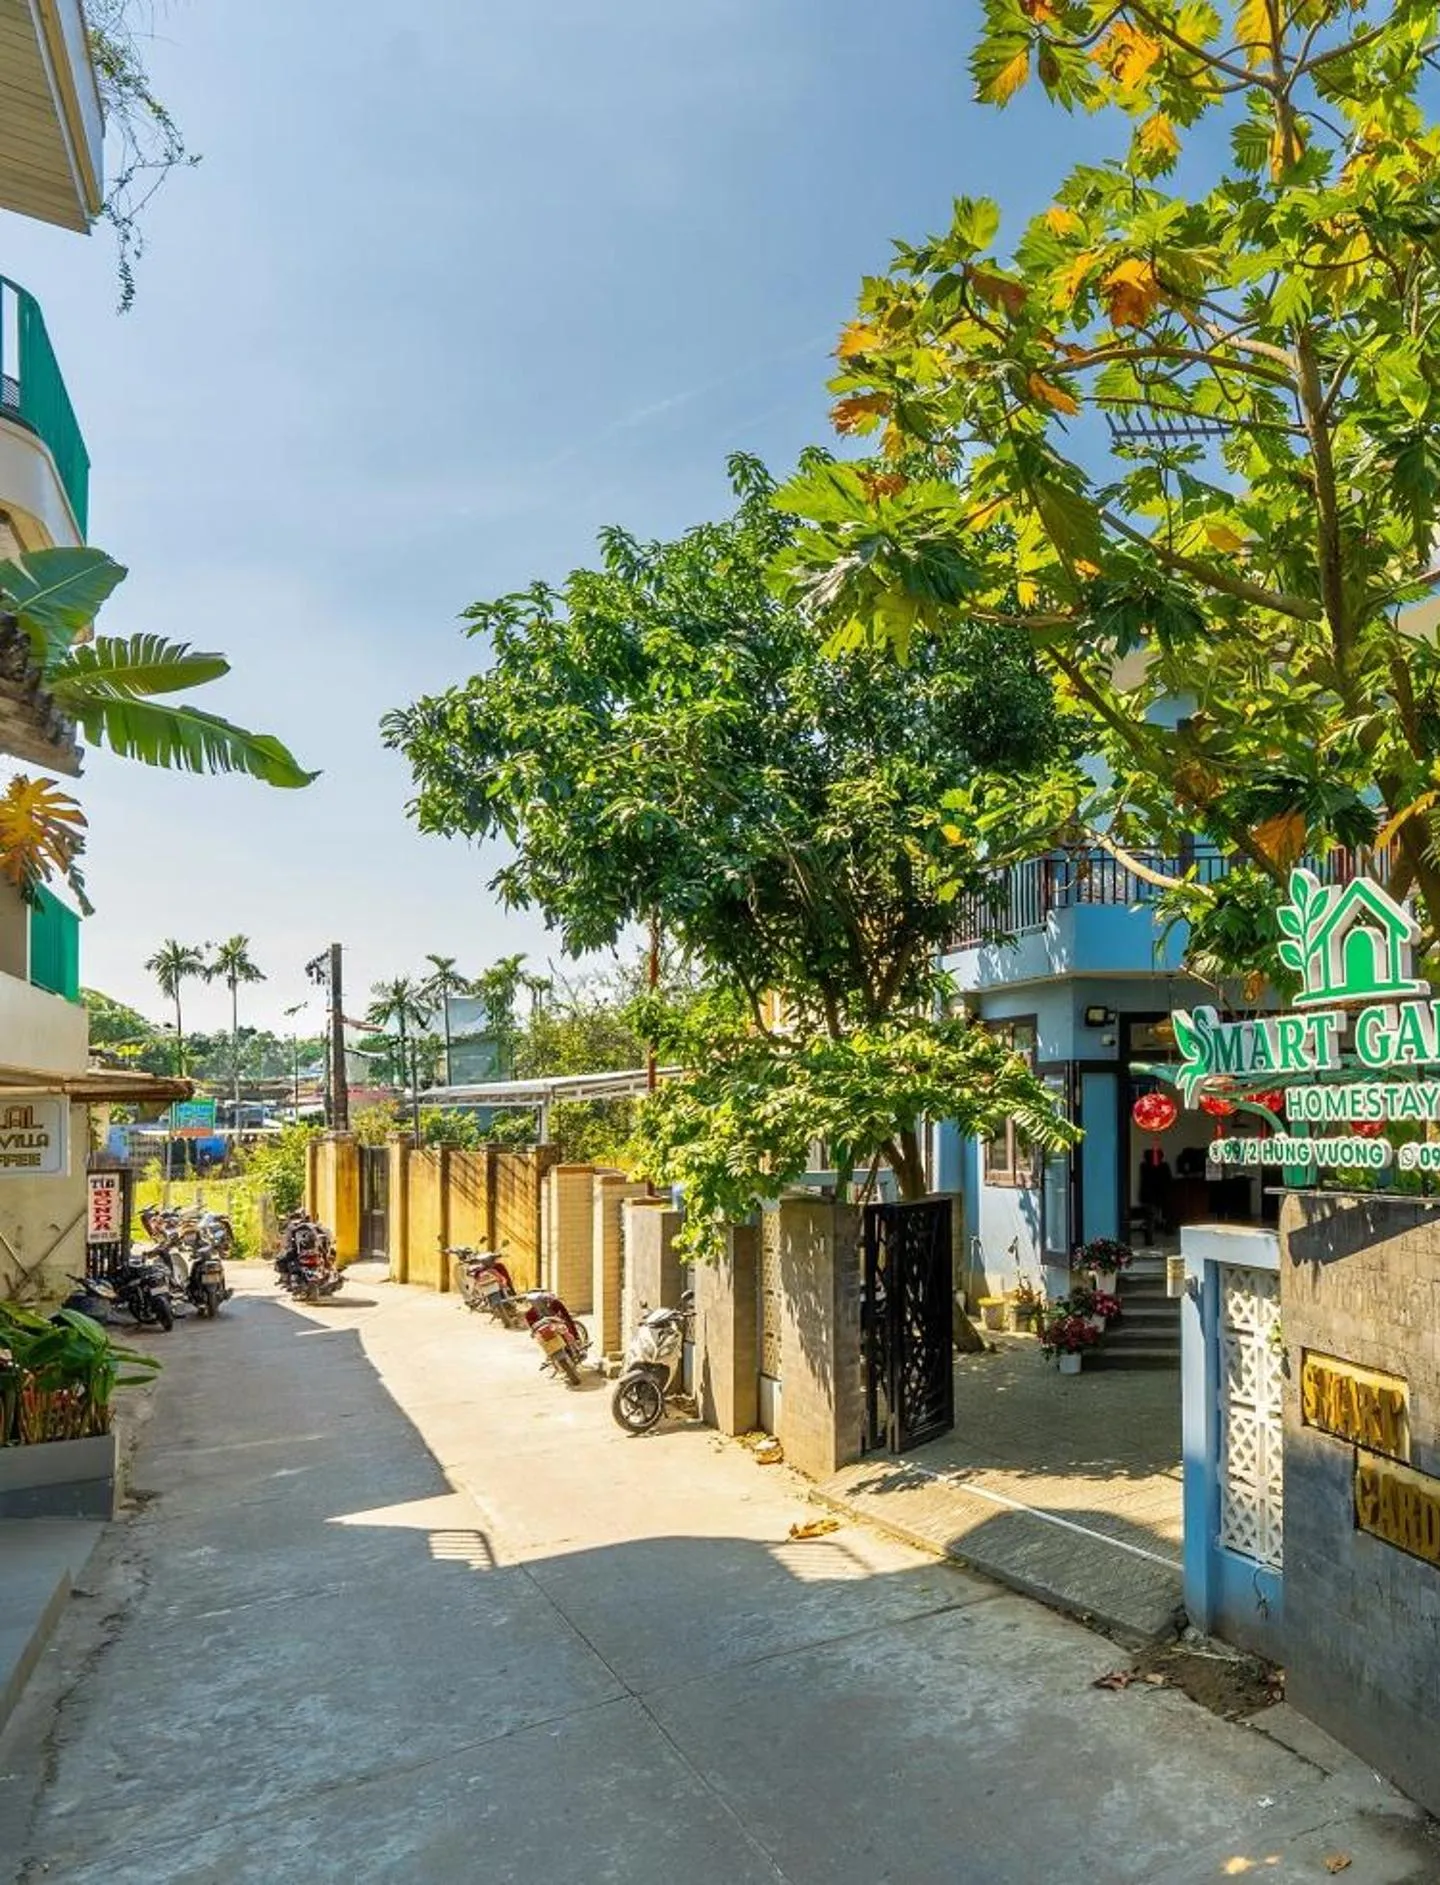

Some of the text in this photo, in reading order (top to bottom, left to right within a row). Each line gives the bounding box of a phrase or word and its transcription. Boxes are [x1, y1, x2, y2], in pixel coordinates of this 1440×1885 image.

[1175, 1006, 1340, 1082] SMART
[1287, 1086, 1440, 1119] HOMESTAY
[1224, 1142, 1257, 1163] 99/2
